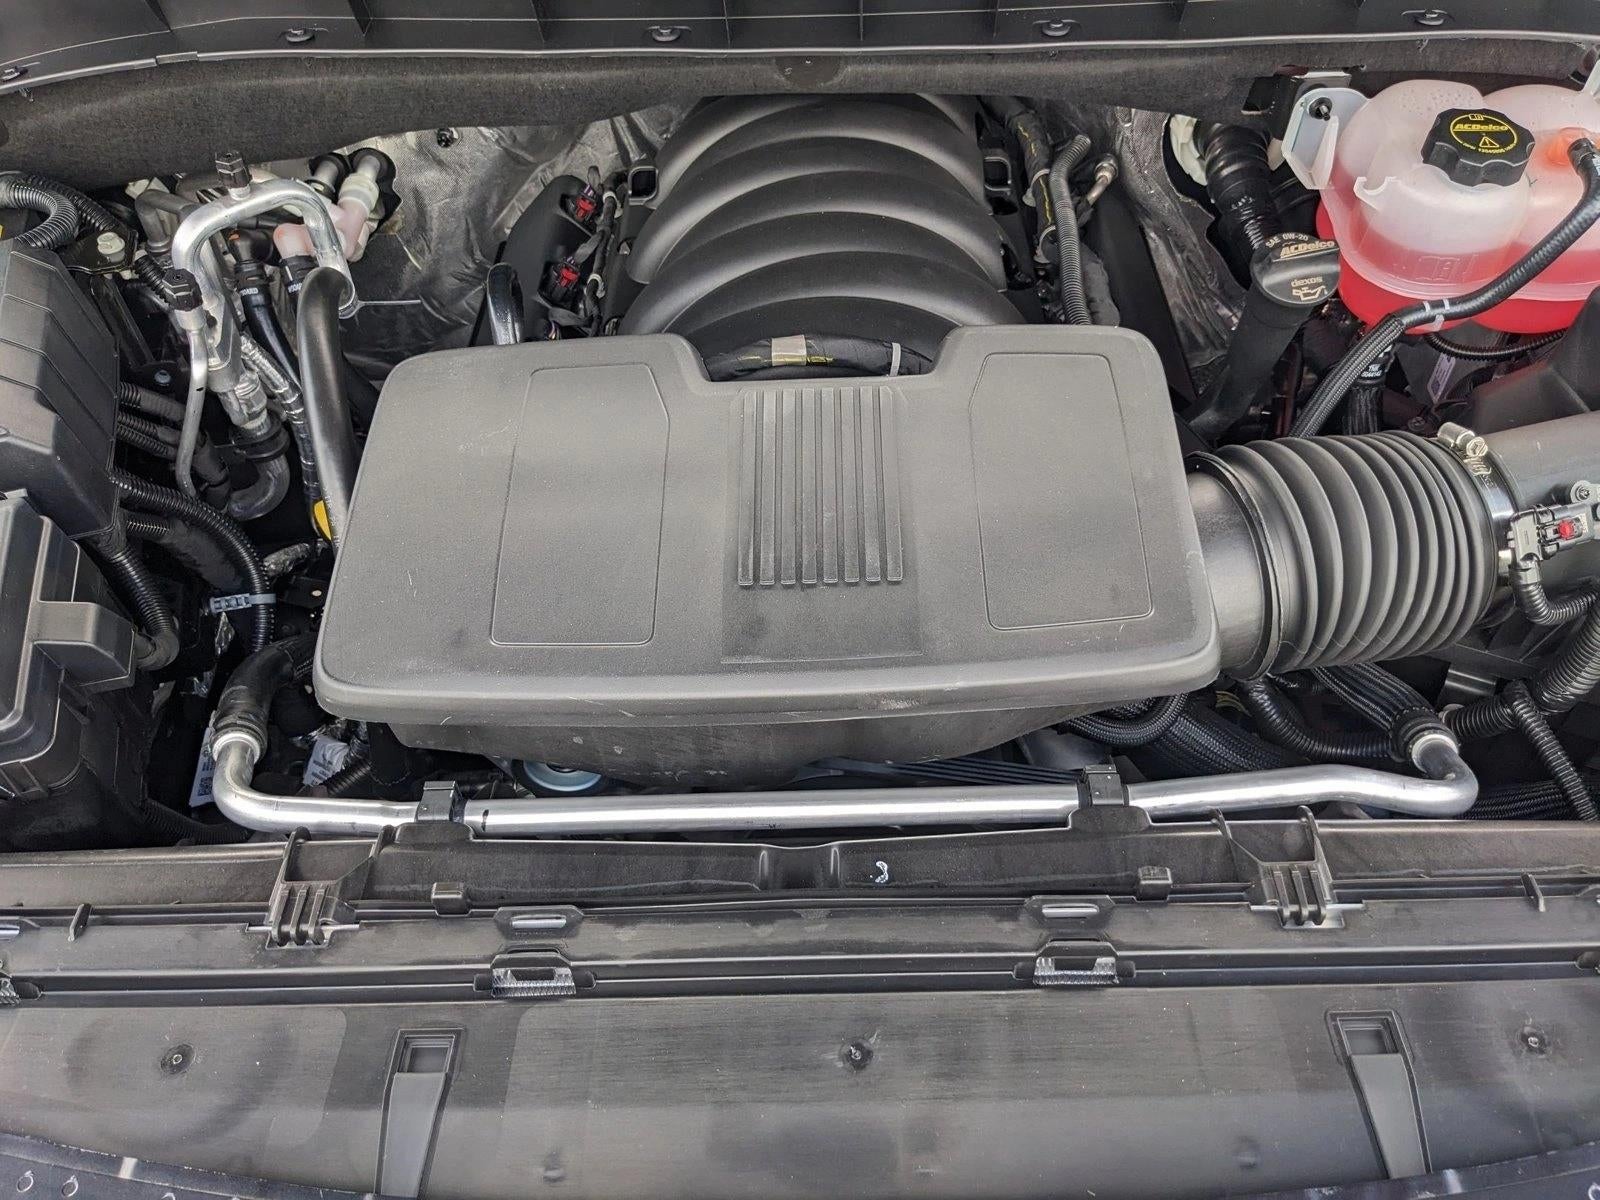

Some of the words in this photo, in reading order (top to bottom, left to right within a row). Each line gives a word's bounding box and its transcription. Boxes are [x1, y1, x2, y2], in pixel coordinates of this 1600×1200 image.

[1453, 123, 1508, 131] ACDelco
[1265, 236, 1280, 248] SAE
[1280, 240, 1335, 257] ACDelco
[1291, 276, 1322, 287] dexos
